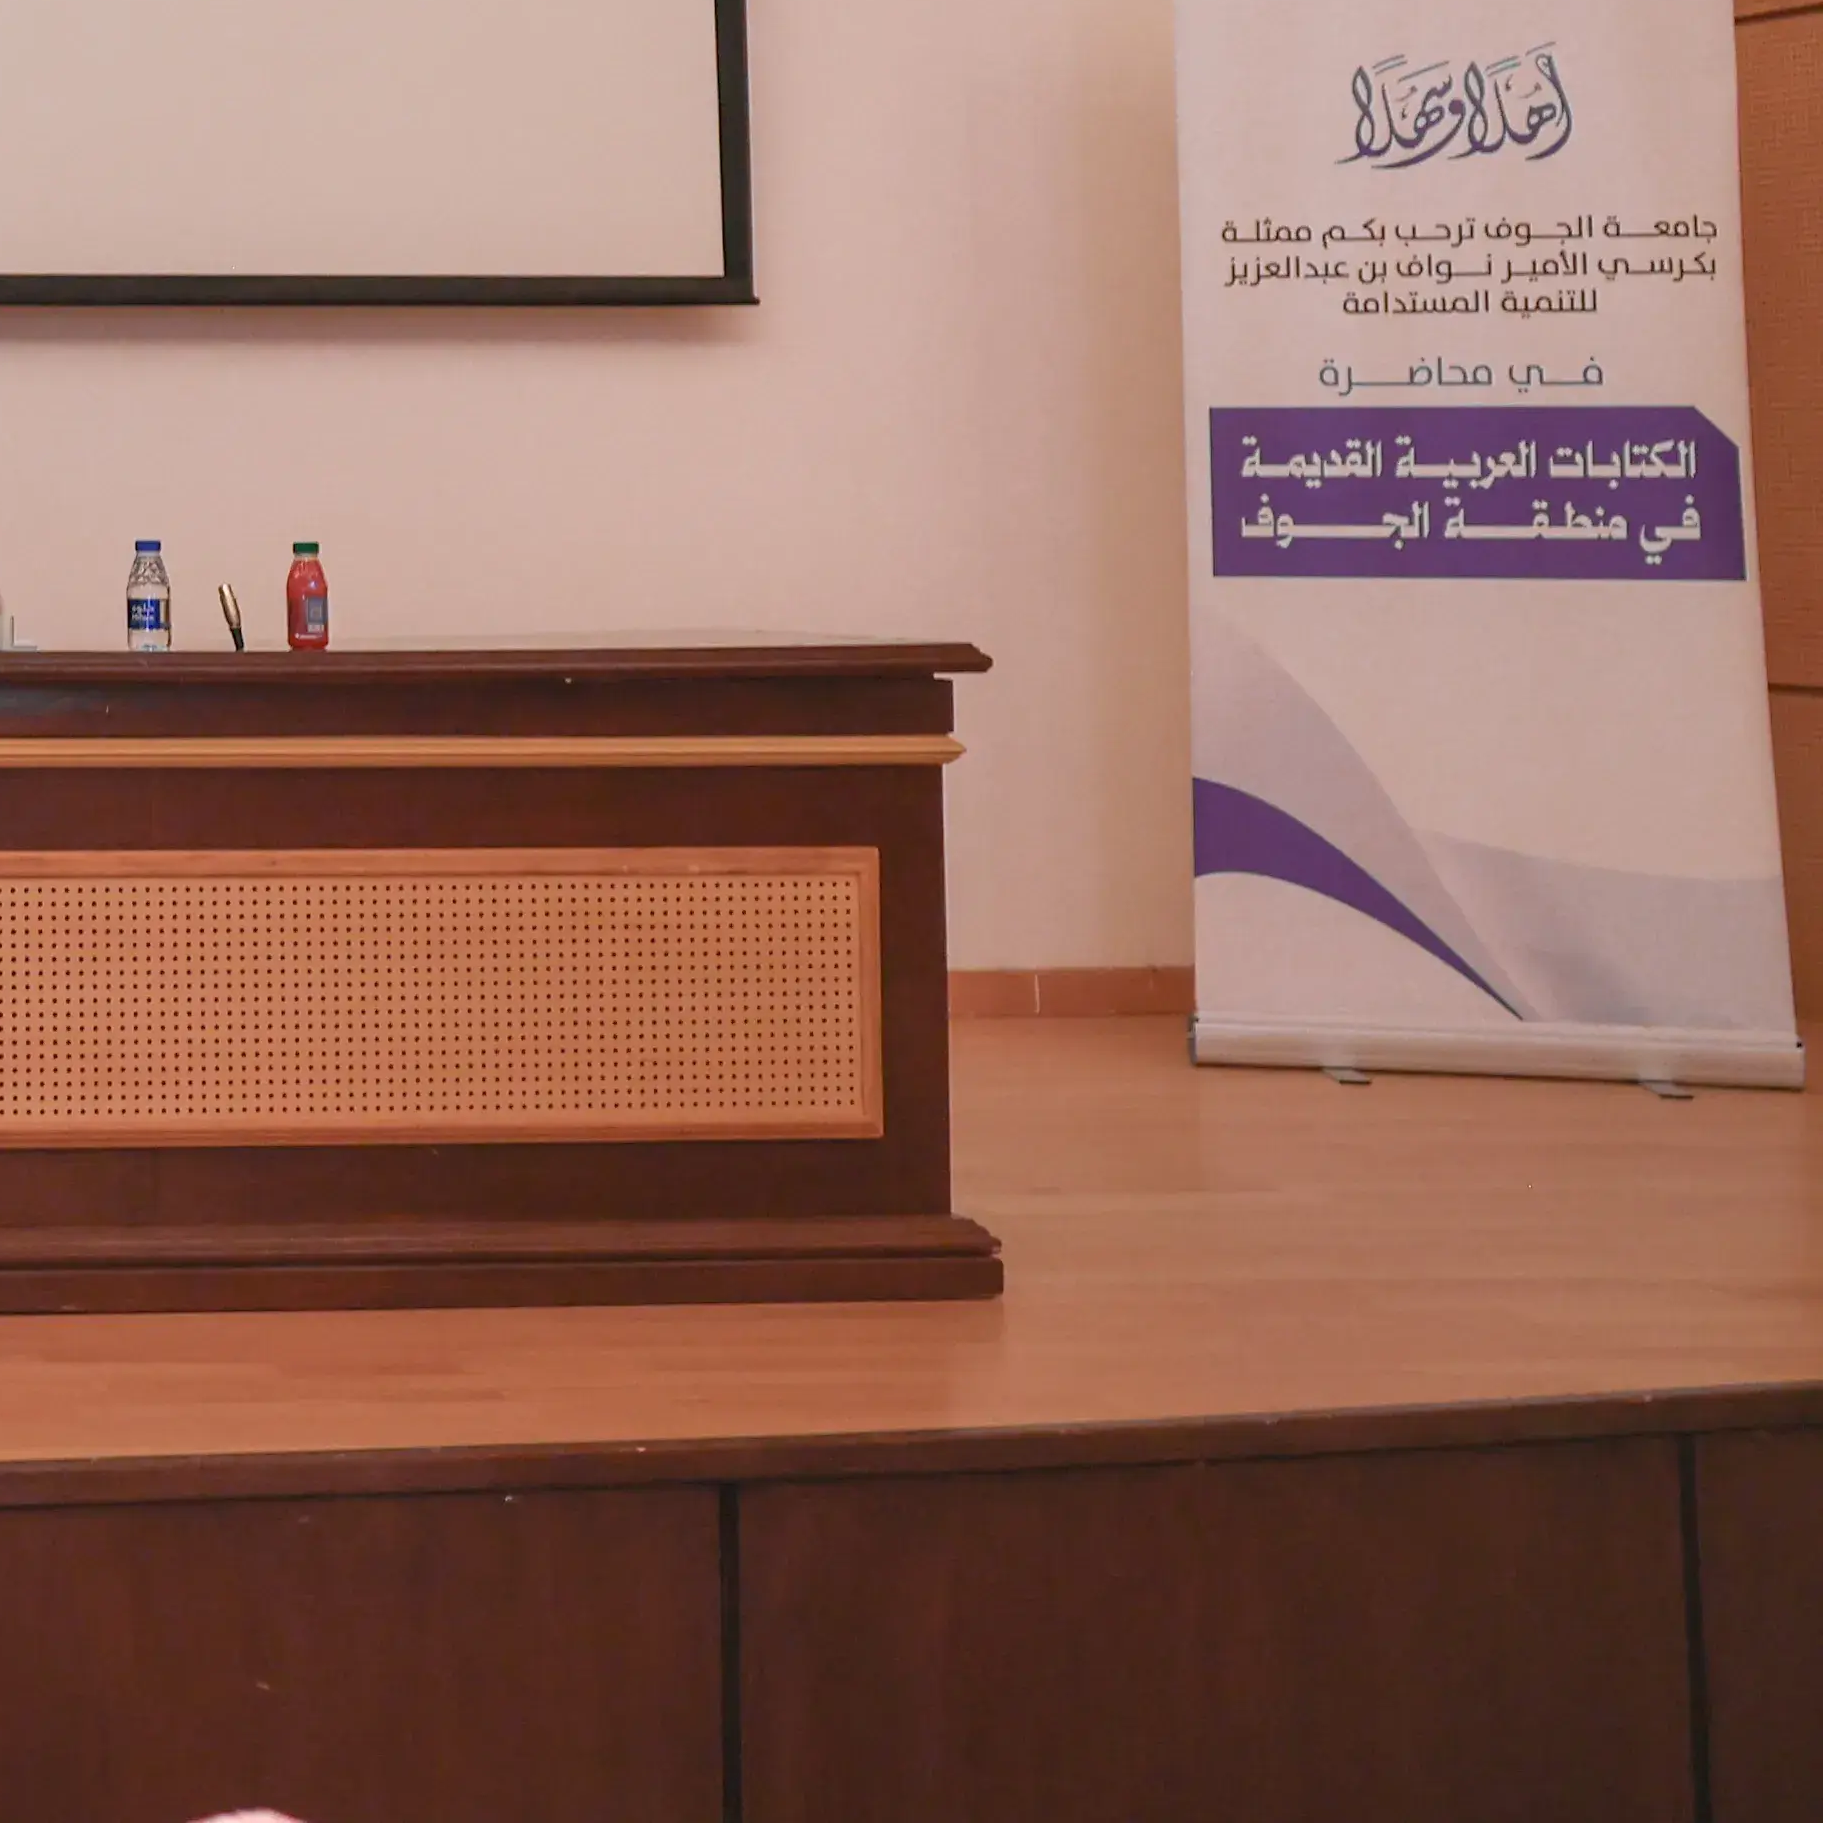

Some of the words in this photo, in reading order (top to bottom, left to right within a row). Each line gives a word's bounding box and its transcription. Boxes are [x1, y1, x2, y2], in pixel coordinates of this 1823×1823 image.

[1221, 217, 1311, 243] ممثلة
[1322, 218, 1385, 249] بكم
[1395, 218, 1475, 248] ترحب
[1484, 215, 1593, 247] الجوف
[1603, 214, 1717, 244] جامعة
[1225, 256, 1349, 287] عبدالعزيز
[1358, 262, 1387, 285] بن
[1396, 253, 1492, 285] نواف
[1500, 249, 1587, 284] الأمير
[1597, 251, 1716, 282] بكرسي
[1343, 290, 1489, 314] المستدامة
[1500, 289, 1597, 318] للتنمية
[1319, 357, 1492, 396] محاضرة
[1508, 357, 1603, 393] في
[1242, 437, 1381, 488] القديمة
[1396, 436, 1535, 488] العربية
[1550, 440, 1695, 488] الكتابات
[1242, 494, 1429, 549] الجوف
[1444, 497, 1626, 538] منطقة
[1639, 494, 1702, 565] في
